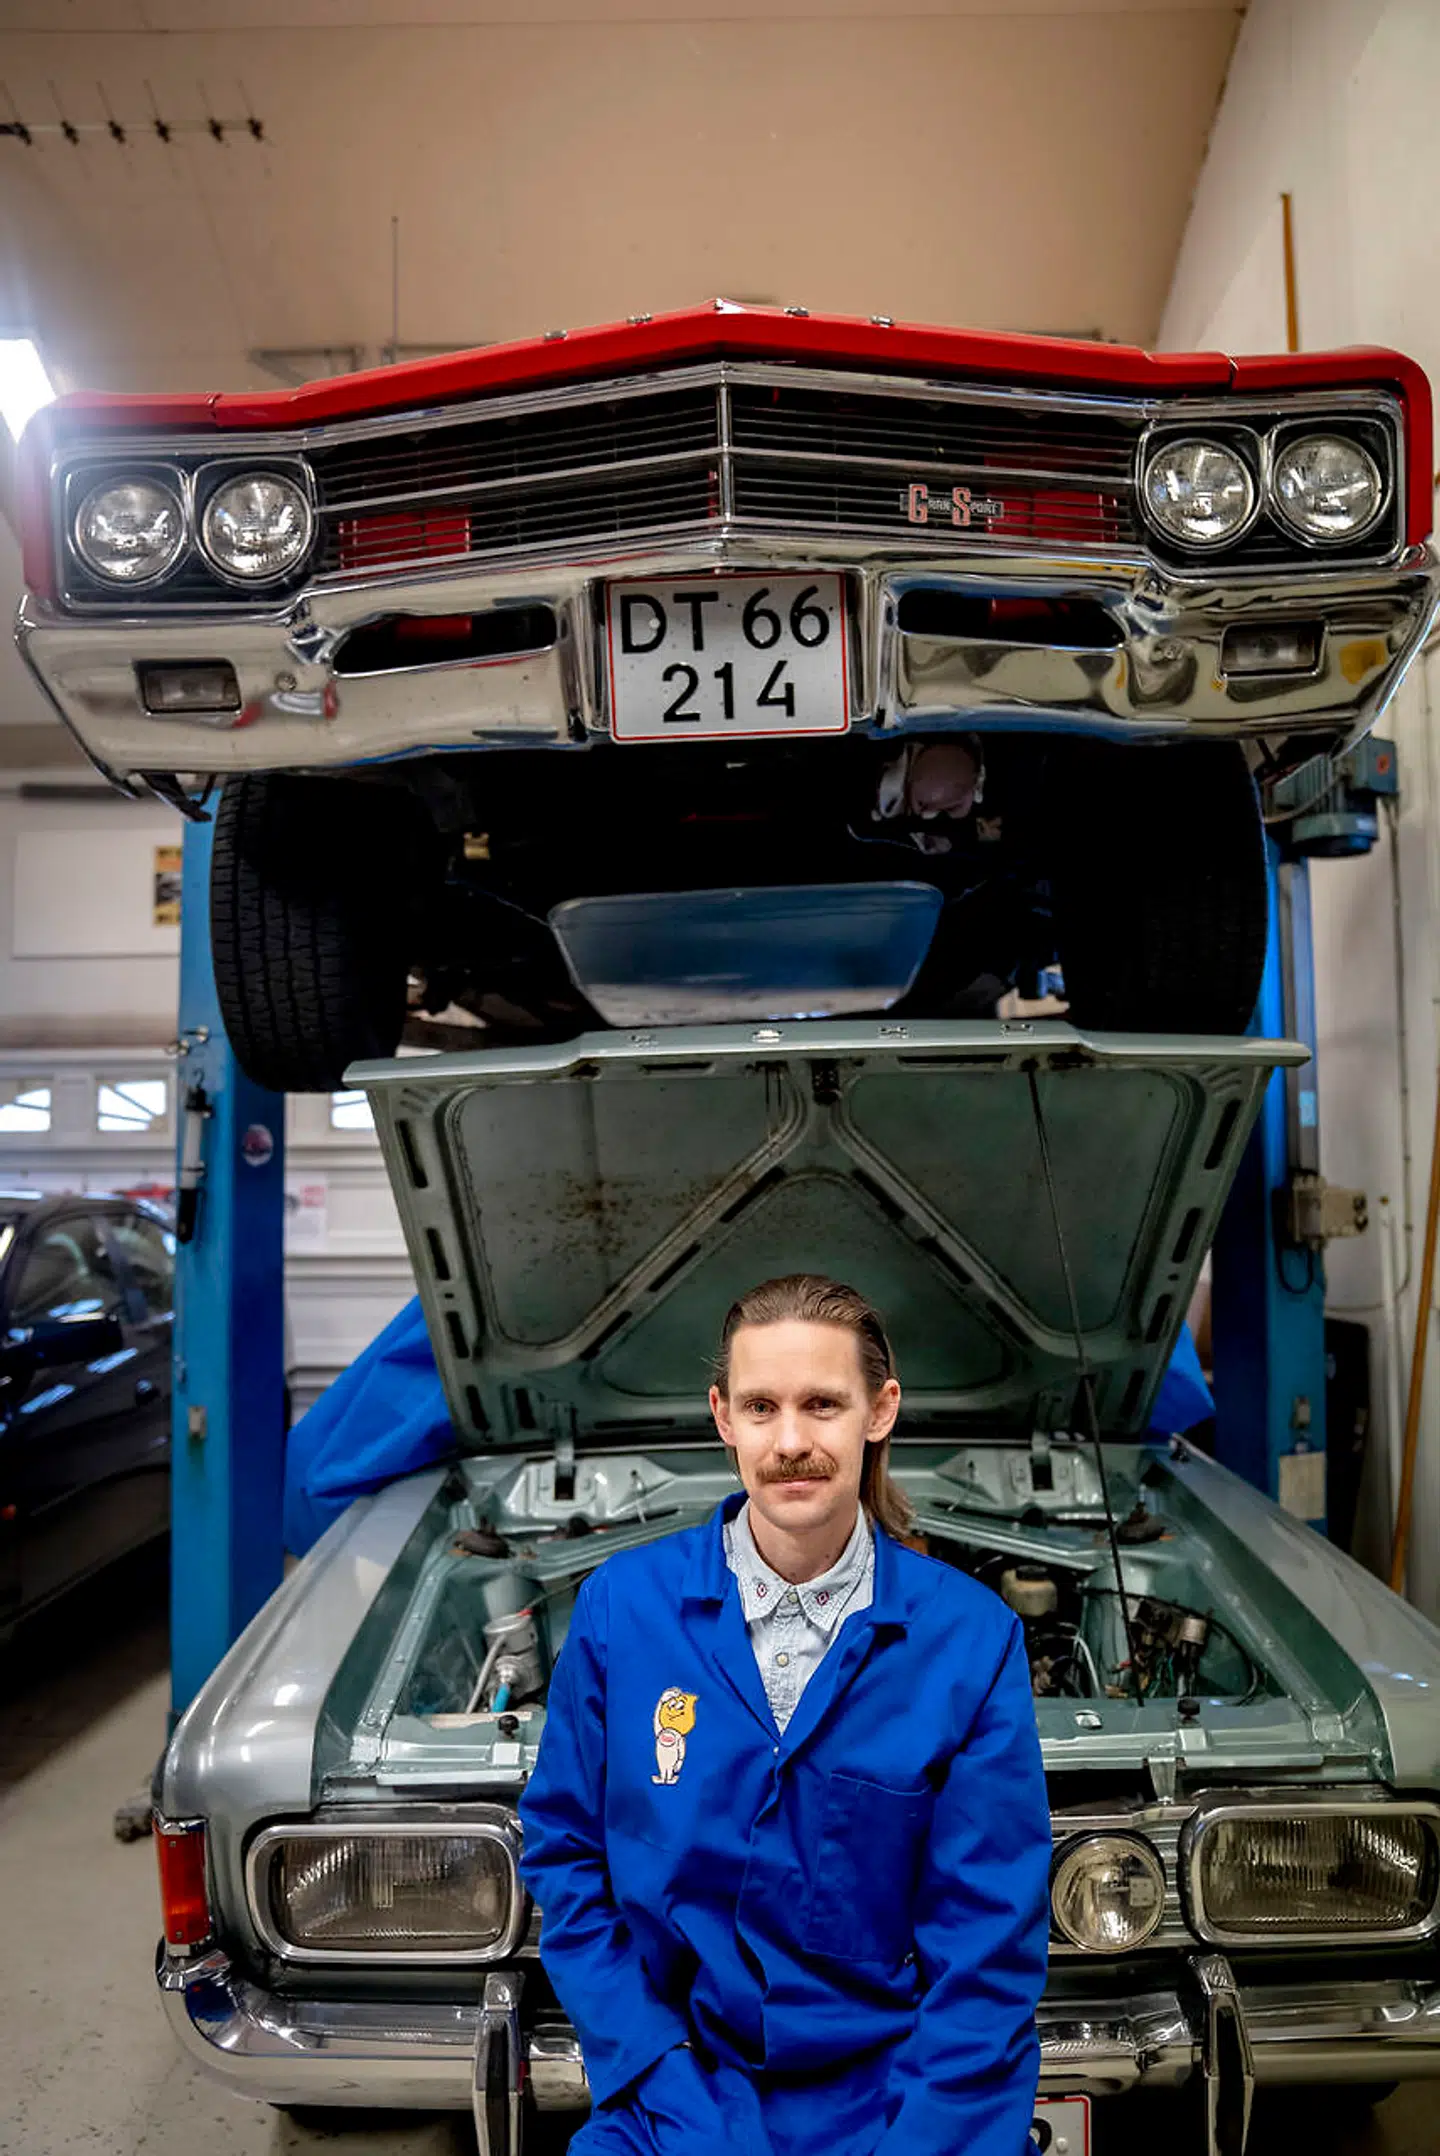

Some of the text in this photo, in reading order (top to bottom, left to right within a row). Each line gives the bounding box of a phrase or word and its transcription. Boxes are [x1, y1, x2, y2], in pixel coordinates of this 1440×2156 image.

[952, 487, 999, 526] SPORT
[620, 585, 830, 654] DT 66
[662, 660, 796, 723] 214
